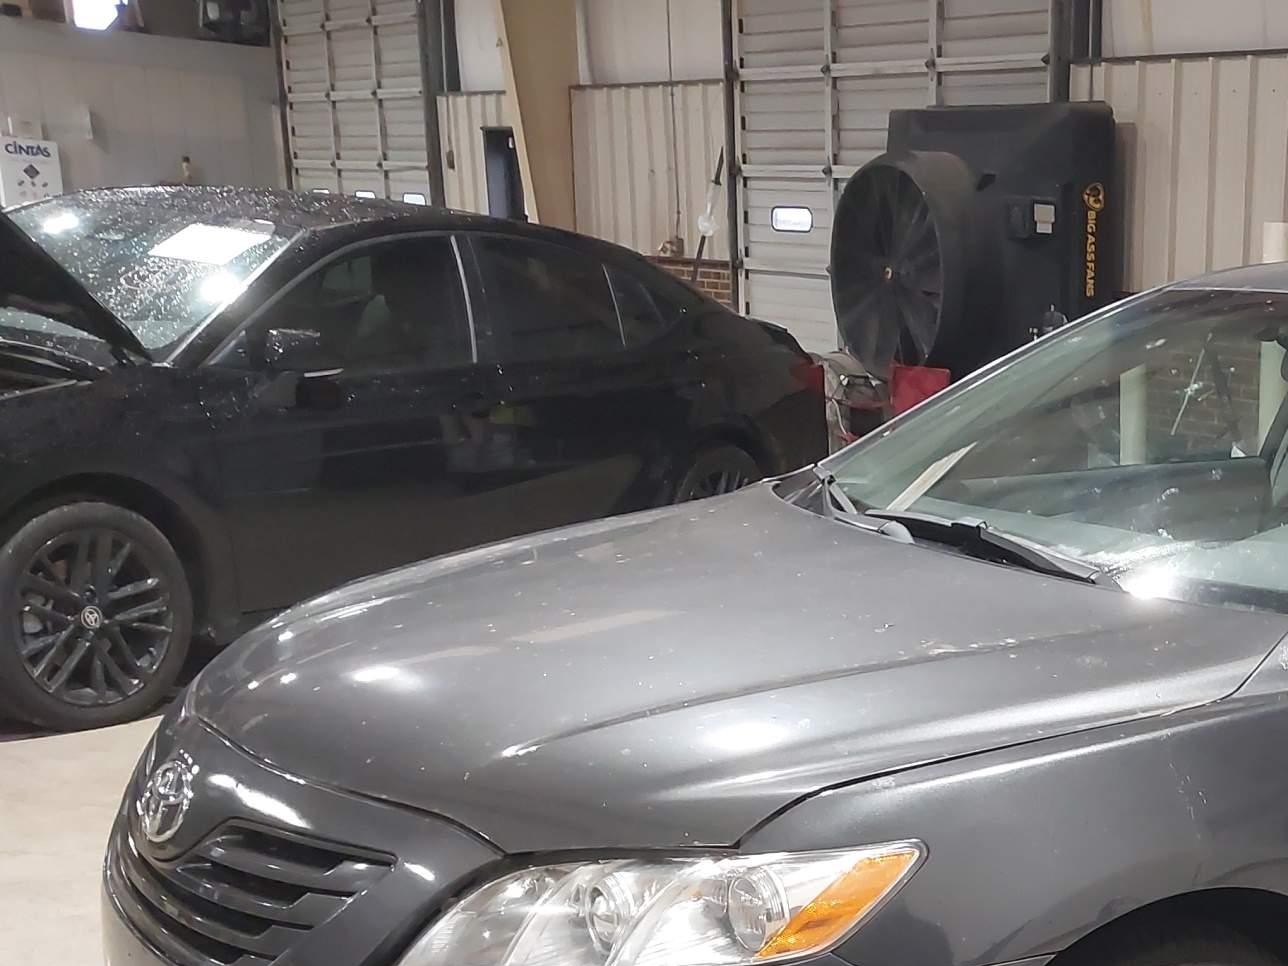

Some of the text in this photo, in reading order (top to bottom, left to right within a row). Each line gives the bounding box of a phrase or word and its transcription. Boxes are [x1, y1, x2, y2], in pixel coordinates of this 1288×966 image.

[1086, 211, 1097, 297] BIG ASS FANS
